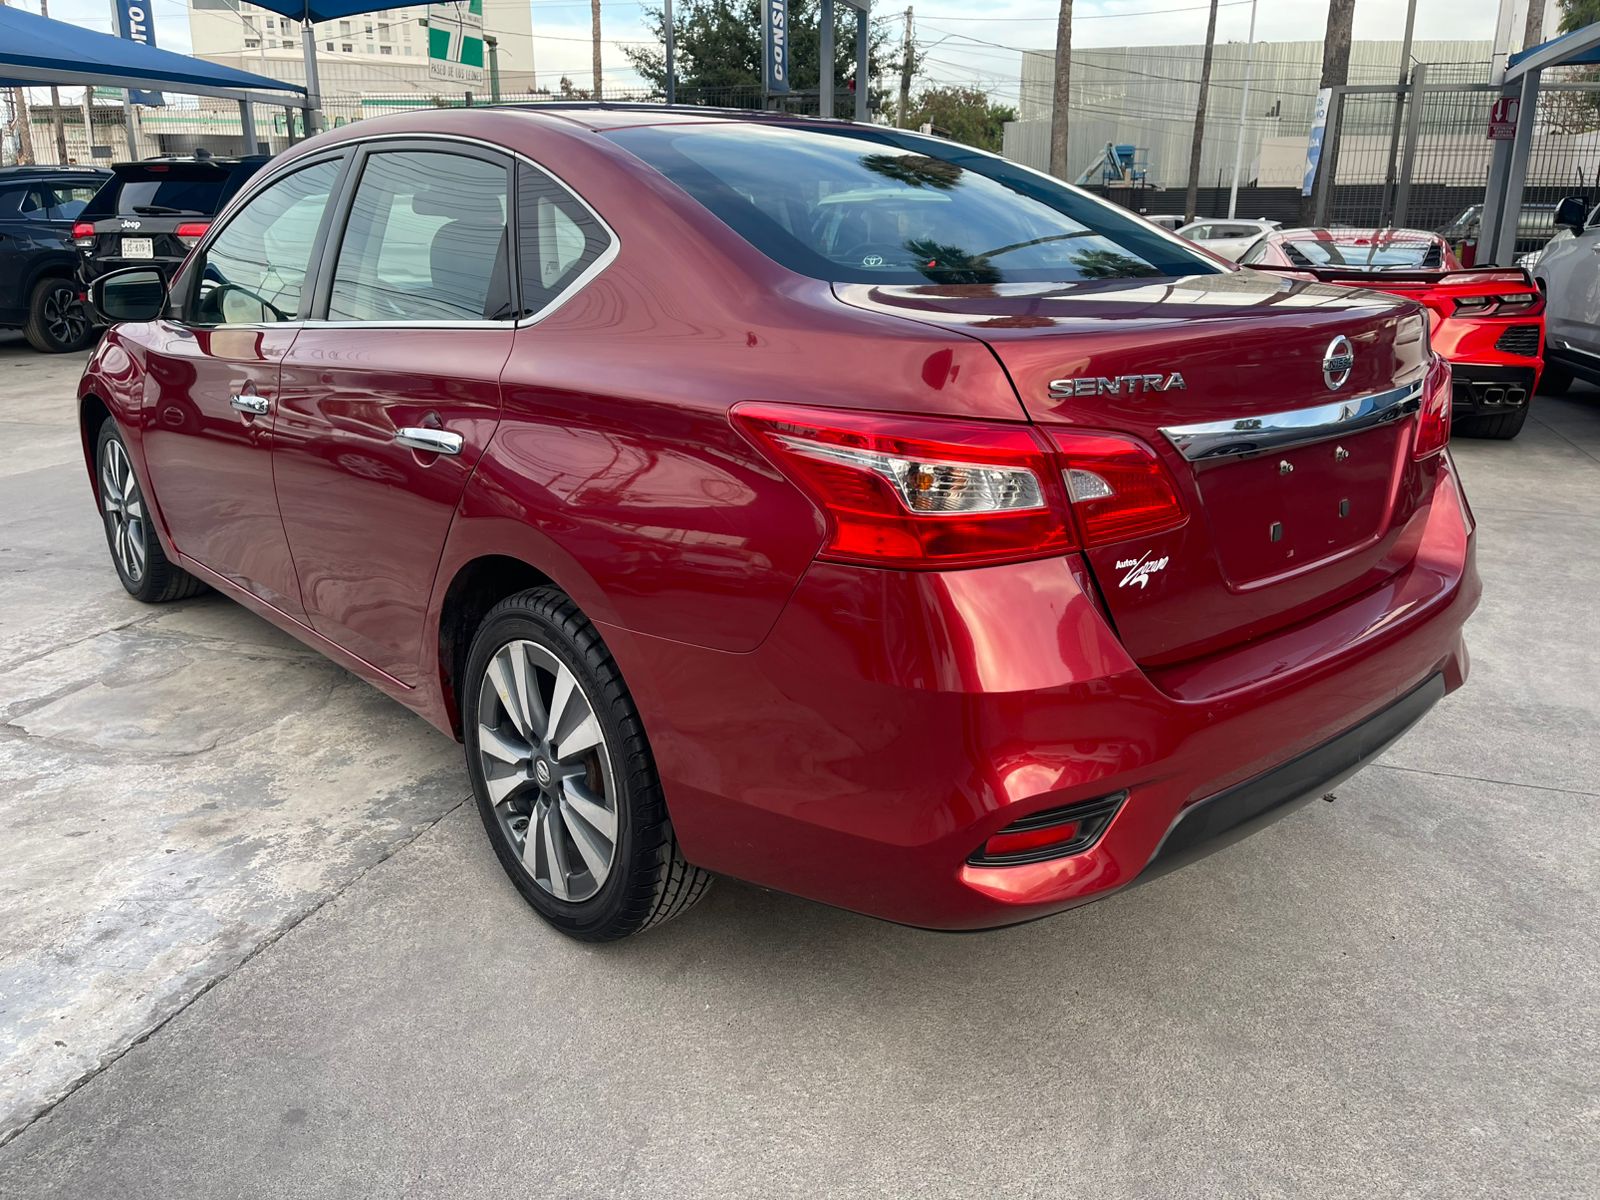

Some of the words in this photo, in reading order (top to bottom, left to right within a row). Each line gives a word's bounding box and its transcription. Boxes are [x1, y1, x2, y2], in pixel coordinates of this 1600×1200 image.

[121, 219, 141, 230] Jeep
[1048, 372, 1186, 398] SENTRA
[1115, 558, 1138, 569] Autos
